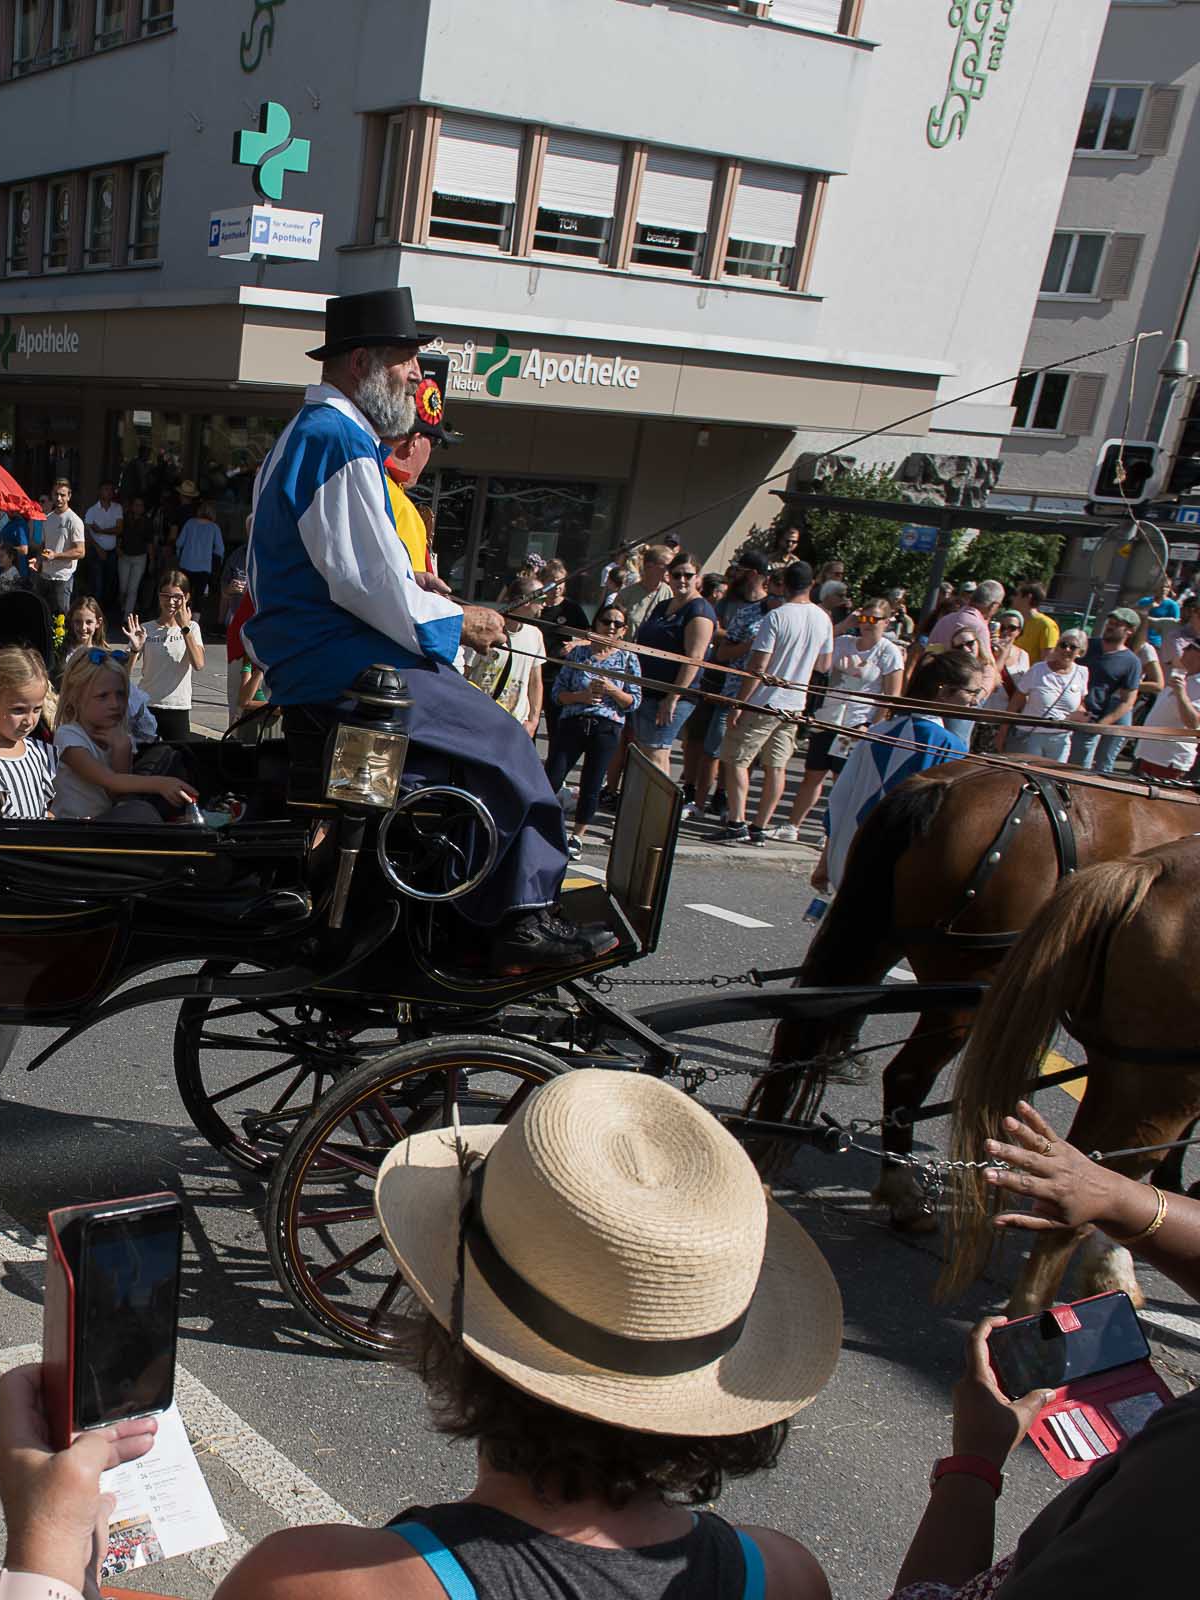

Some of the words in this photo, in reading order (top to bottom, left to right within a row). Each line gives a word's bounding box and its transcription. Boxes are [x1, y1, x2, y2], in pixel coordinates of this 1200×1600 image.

[255, 219, 268, 238] P
[272, 231, 312, 246] Apotheke
[17, 323, 79, 360] Apotheke
[522, 348, 640, 389] Apotheke
[453, 375, 484, 392] Natur
